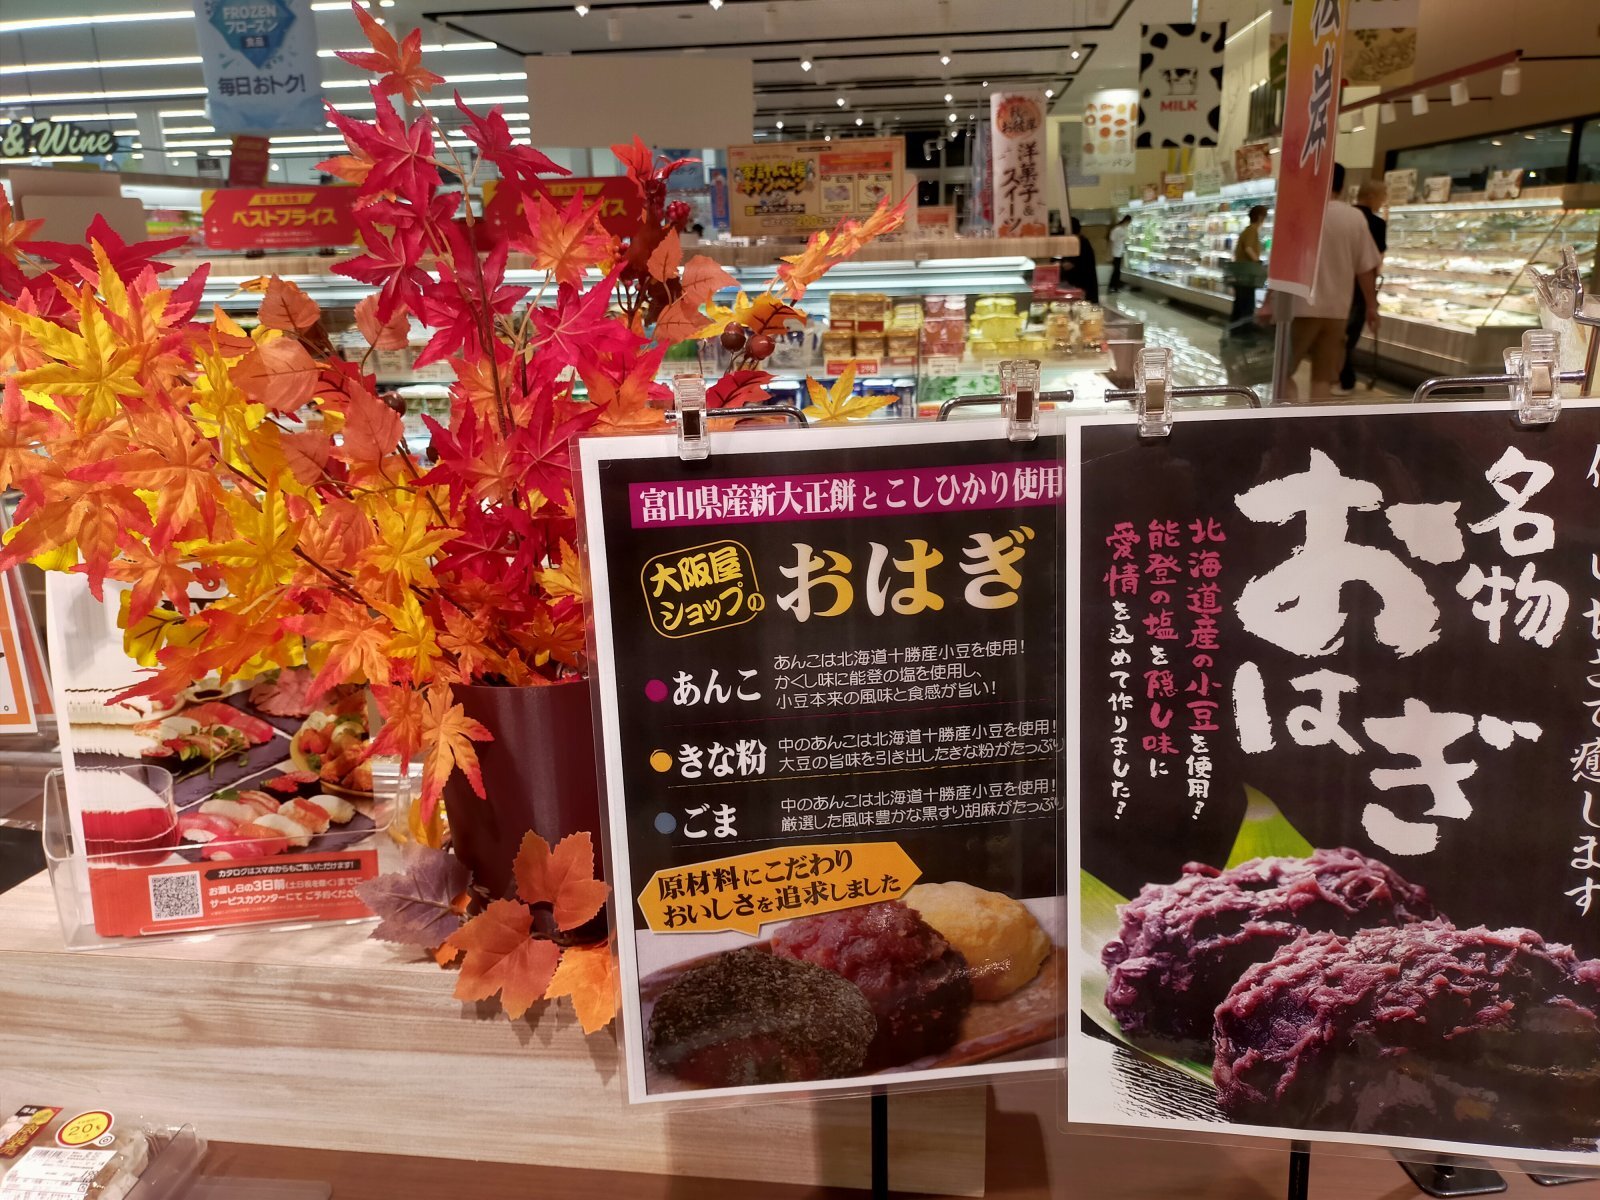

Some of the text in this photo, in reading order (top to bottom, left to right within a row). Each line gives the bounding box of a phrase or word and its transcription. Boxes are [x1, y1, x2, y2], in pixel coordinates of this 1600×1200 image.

[222, 6, 277, 20] FROZEN
[218, 74, 306, 96] 毎日おトク!
[1160, 100, 1198, 112] MILK
[2, 121, 113, 156] & Wine
[1001, 168, 1022, 233] スイーツ
[1456, 445, 1570, 648] 名物
[649, 546, 743, 599] 大阪屋
[776, 525, 1035, 623] おはぎ
[774, 639, 1026, 671] あんこは北海道十勝産小豆を使用!
[672, 668, 762, 706] あんこ
[776, 680, 997, 710] 小豆本来の風味と食感が旨い!
[778, 718, 1058, 752] 中のあんこは北海道十勝産小豆を使用!
[677, 738, 767, 778] きな粉
[780, 777, 1057, 812] 中のあんこは北海道十勝産小豆を使用!
[683, 803, 739, 839] ごま
[658, 848, 854, 899] 原材料にこだわり
[662, 872, 902, 928] おいしさを追求しました
